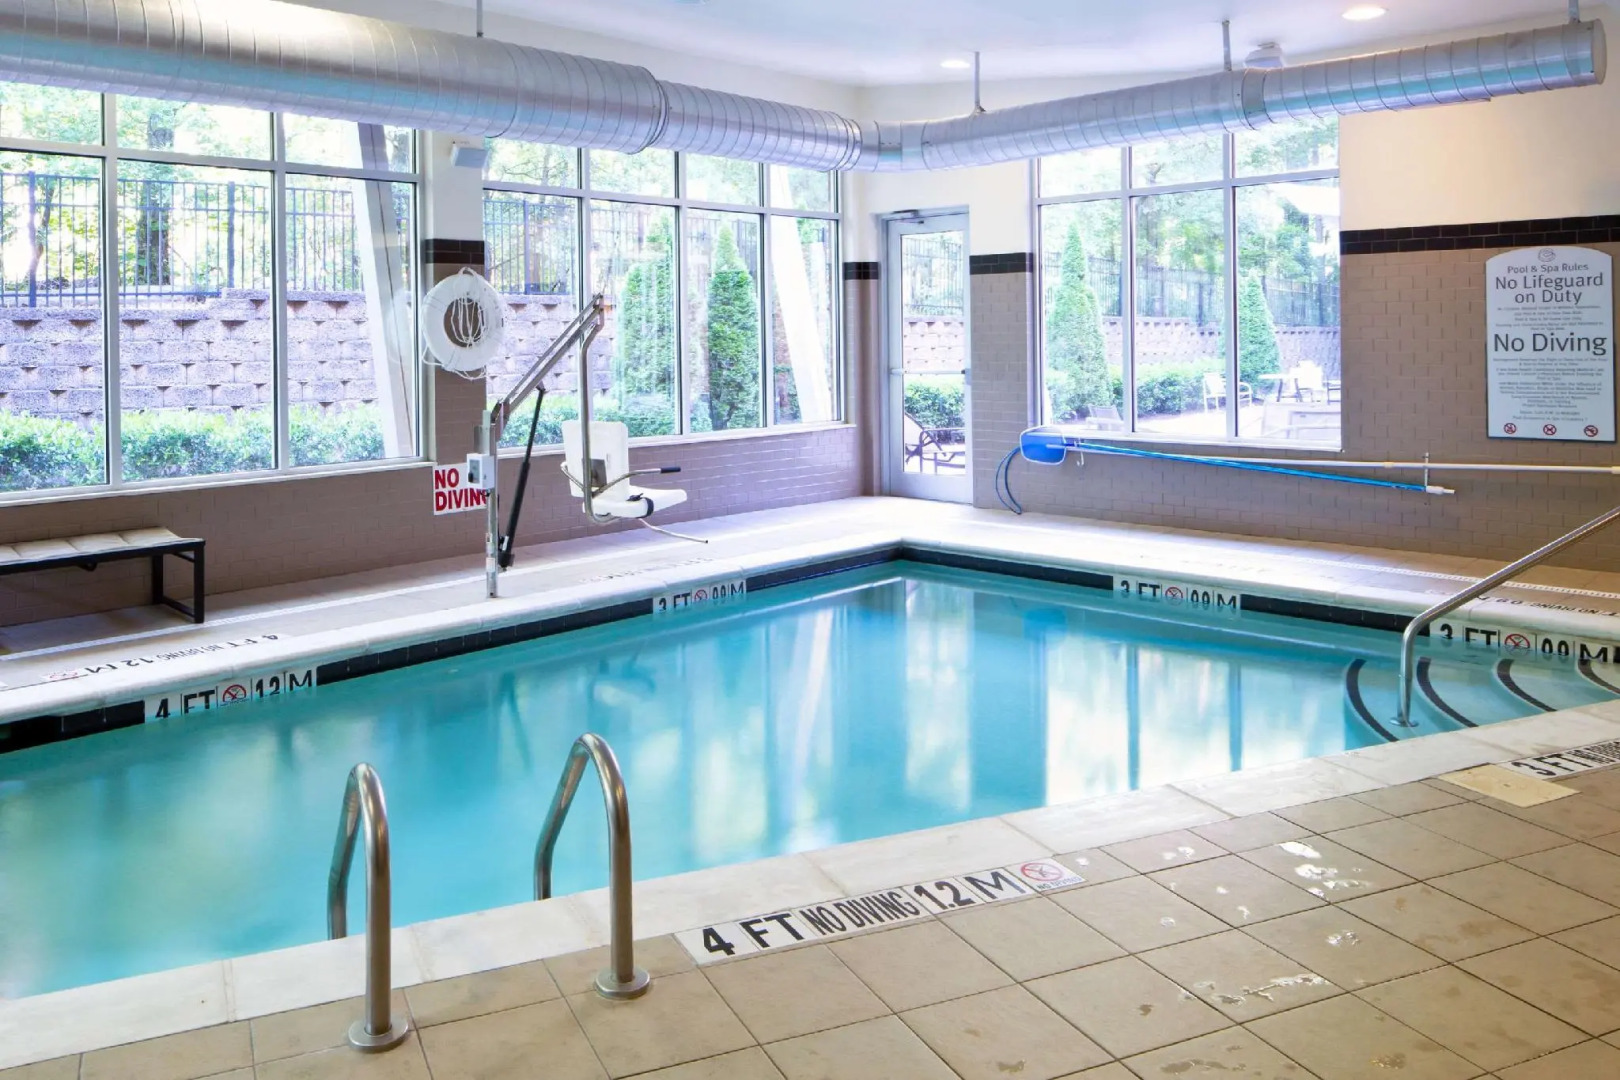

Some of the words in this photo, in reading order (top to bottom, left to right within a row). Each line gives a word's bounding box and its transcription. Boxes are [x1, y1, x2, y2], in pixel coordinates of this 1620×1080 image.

[1507, 265, 1528, 274] Pool
[1530, 265, 1538, 273] &
[1540, 264, 1559, 274] Spa
[1562, 262, 1589, 272] Rules
[1495, 276, 1517, 290] No
[1523, 272, 1604, 291] Lifeguard
[1514, 293, 1535, 304] on
[1542, 290, 1583, 305] Duty
[1494, 333, 1525, 352] No
[1532, 332, 1608, 356] Diving
[434, 467, 459, 490] NO
[730, 581, 744, 595] M
[1217, 593, 1237, 609] M
[226, 637, 257, 649] FT
[1580, 643, 1608, 662] M
[84, 663, 119, 675] M
[155, 697, 171, 719] 4
[184, 689, 216, 714] FT
[289, 670, 312, 691] M
[1510, 760, 1558, 777] 3
[1532, 753, 1593, 772] FT
[702, 926, 735, 956] 4
[739, 912, 805, 948] FT
[799, 904, 846, 936] NO
[837, 890, 921, 929] DIVING
[913, 880, 976, 911] 1.2
[966, 871, 1026, 900] M
